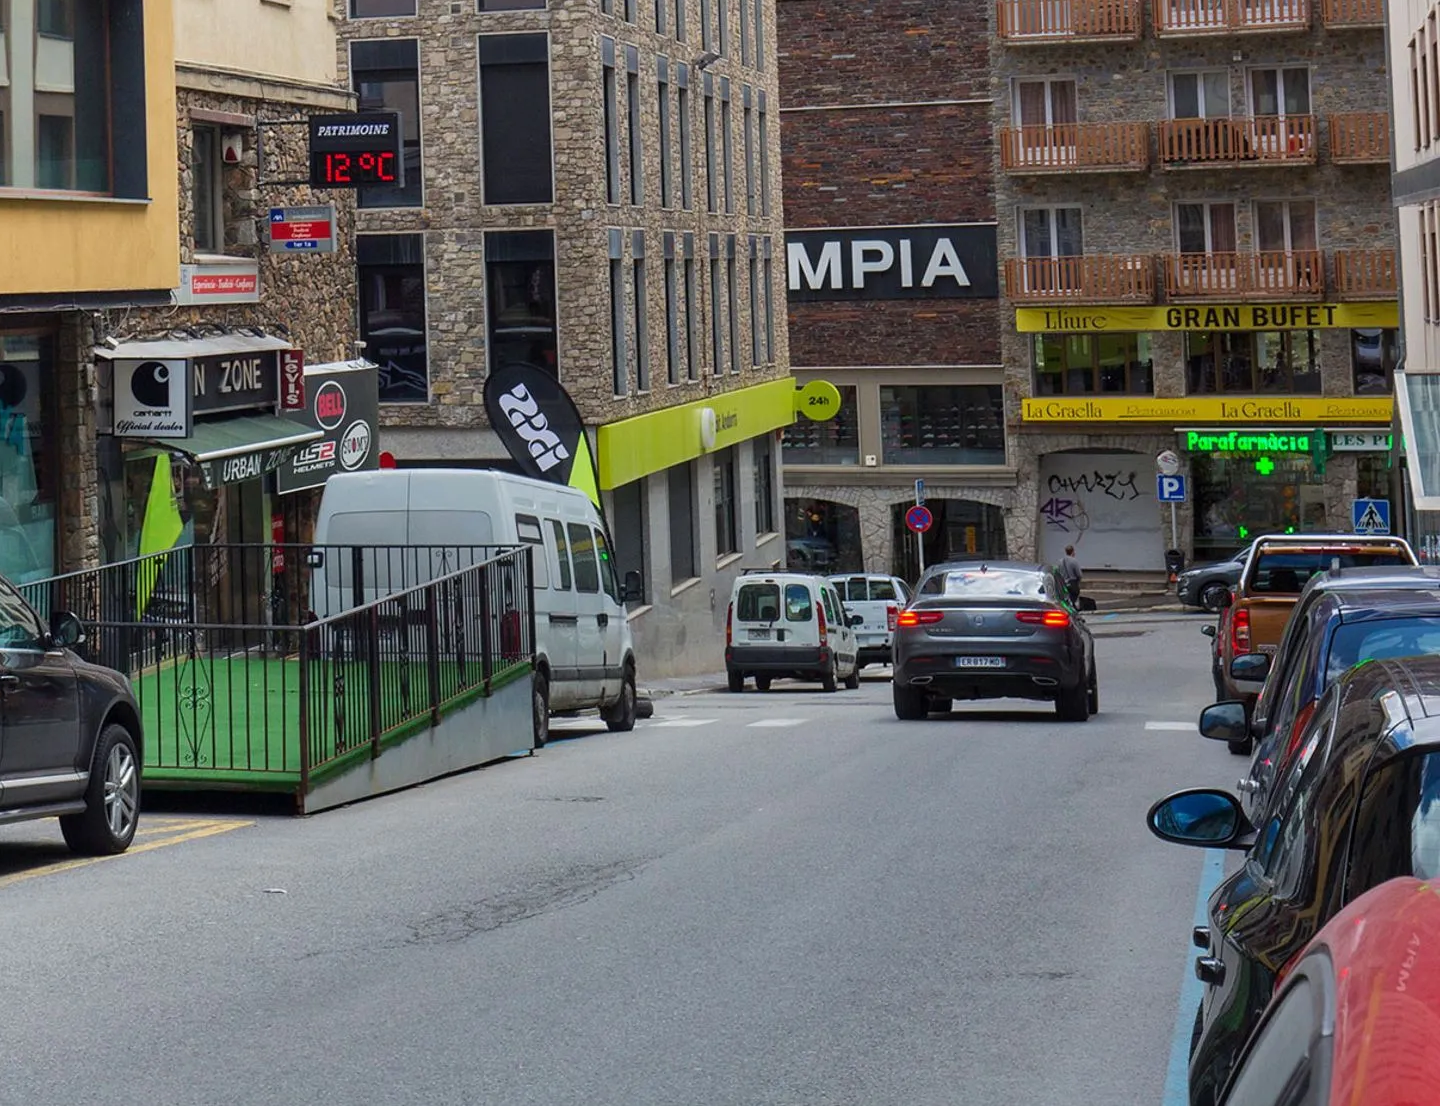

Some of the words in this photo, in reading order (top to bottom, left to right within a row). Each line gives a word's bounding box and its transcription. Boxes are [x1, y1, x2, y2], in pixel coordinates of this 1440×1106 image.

[317, 123, 390, 137] PATRIMOINE
[325, 153, 351, 182] 12
[787, 237, 971, 290] MPIA
[1166, 306, 1240, 329] GRAN
[1252, 305, 1338, 327] BUFET
[221, 359, 262, 393] ZONE
[318, 392, 344, 418] BELL
[808, 396, 830, 406] 24h
[1026, 402, 1044, 418] La
[1046, 401, 1103, 418] Graella
[1221, 402, 1239, 418] La
[1241, 401, 1302, 418] Graella
[133, 410, 172, 418] carhartt
[116, 419, 152, 434] Official
[154, 420, 184, 431] dealer
[1187, 431, 1309, 451] Parafarmàcia
[1332, 434, 1365, 446] LES
[223, 454, 262, 482] URBAN
[293, 460, 336, 474] HELMETS
